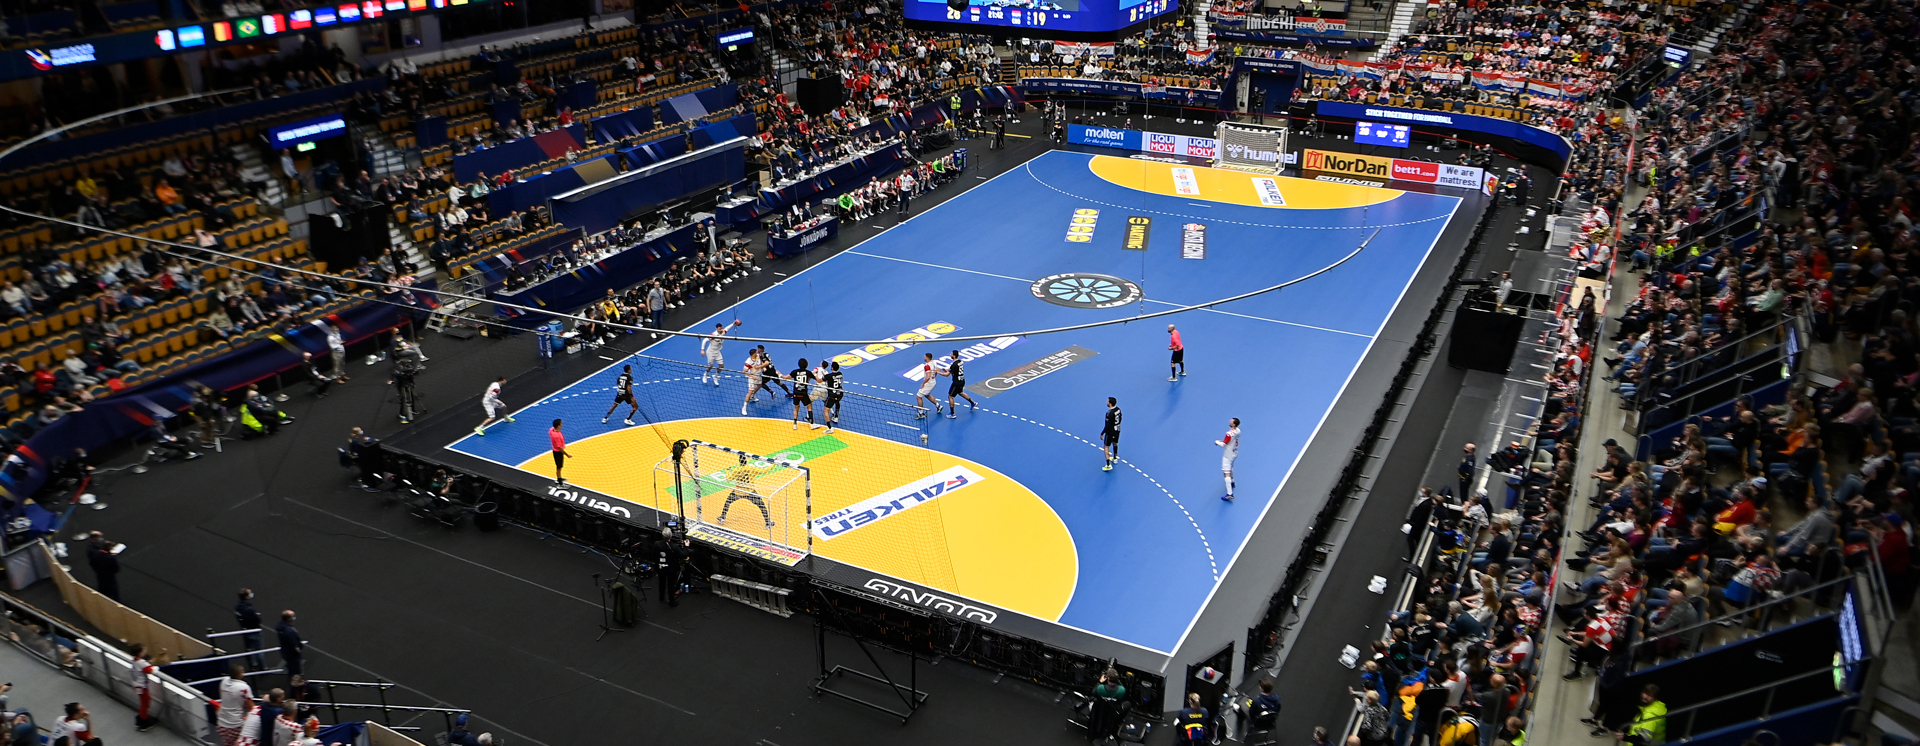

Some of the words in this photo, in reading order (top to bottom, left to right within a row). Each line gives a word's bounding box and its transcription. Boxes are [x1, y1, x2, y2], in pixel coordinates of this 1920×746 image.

[1033, 12, 1046, 26] 19
[1085, 128, 1124, 140] molten
[1151, 134, 1175, 144] LIQUI
[1151, 143, 1175, 152] MOLY
[1189, 138, 1213, 148] LIQUI
[1188, 147, 1213, 157] MOLY
[1243, 146, 1298, 164] hummel
[1325, 155, 1387, 176] NorDan
[1395, 164, 1436, 177] bett1.com
[1446, 166, 1459, 176] We
[1460, 168, 1475, 177] are
[1440, 176, 1479, 187] mattress.
[796, 375, 808, 384] 90
[821, 474, 969, 537] FALKEN
[814, 508, 853, 526] TYRES
